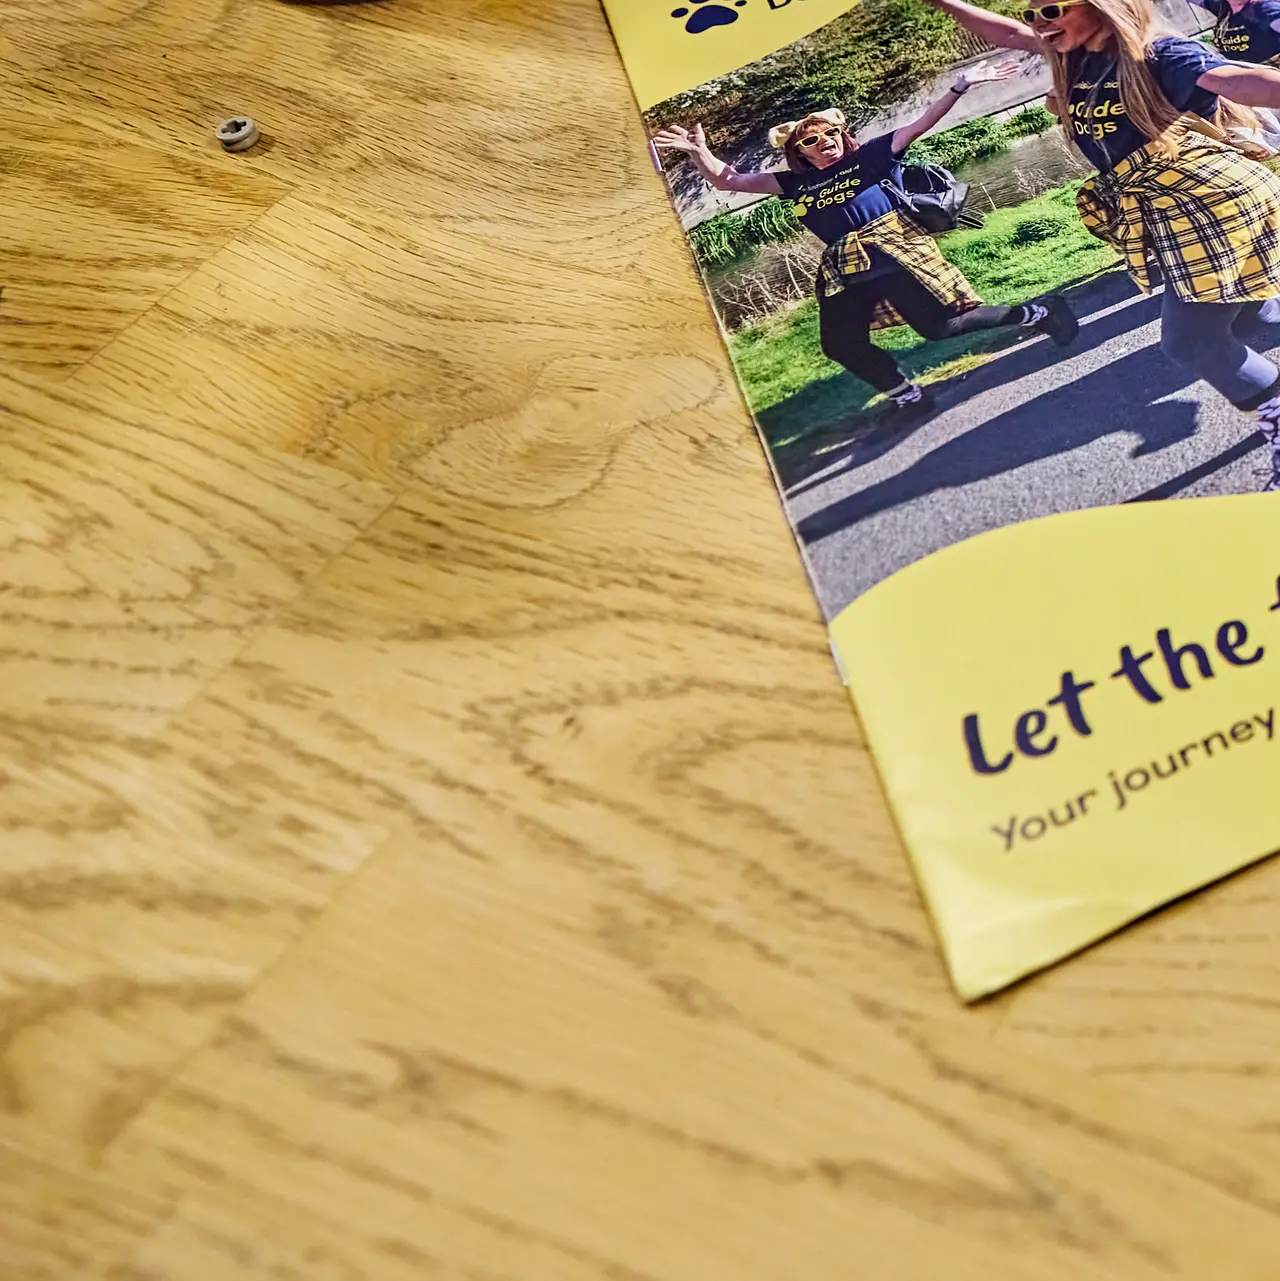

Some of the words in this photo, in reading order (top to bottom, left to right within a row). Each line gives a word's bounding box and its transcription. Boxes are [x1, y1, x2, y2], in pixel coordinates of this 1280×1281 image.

[817, 190, 855, 209] Dogs
[819, 178, 861, 198] Guide
[961, 671, 1095, 775] Let
[1111, 619, 1266, 704] the
[990, 786, 1101, 852] Your
[1107, 707, 1277, 810] journey
